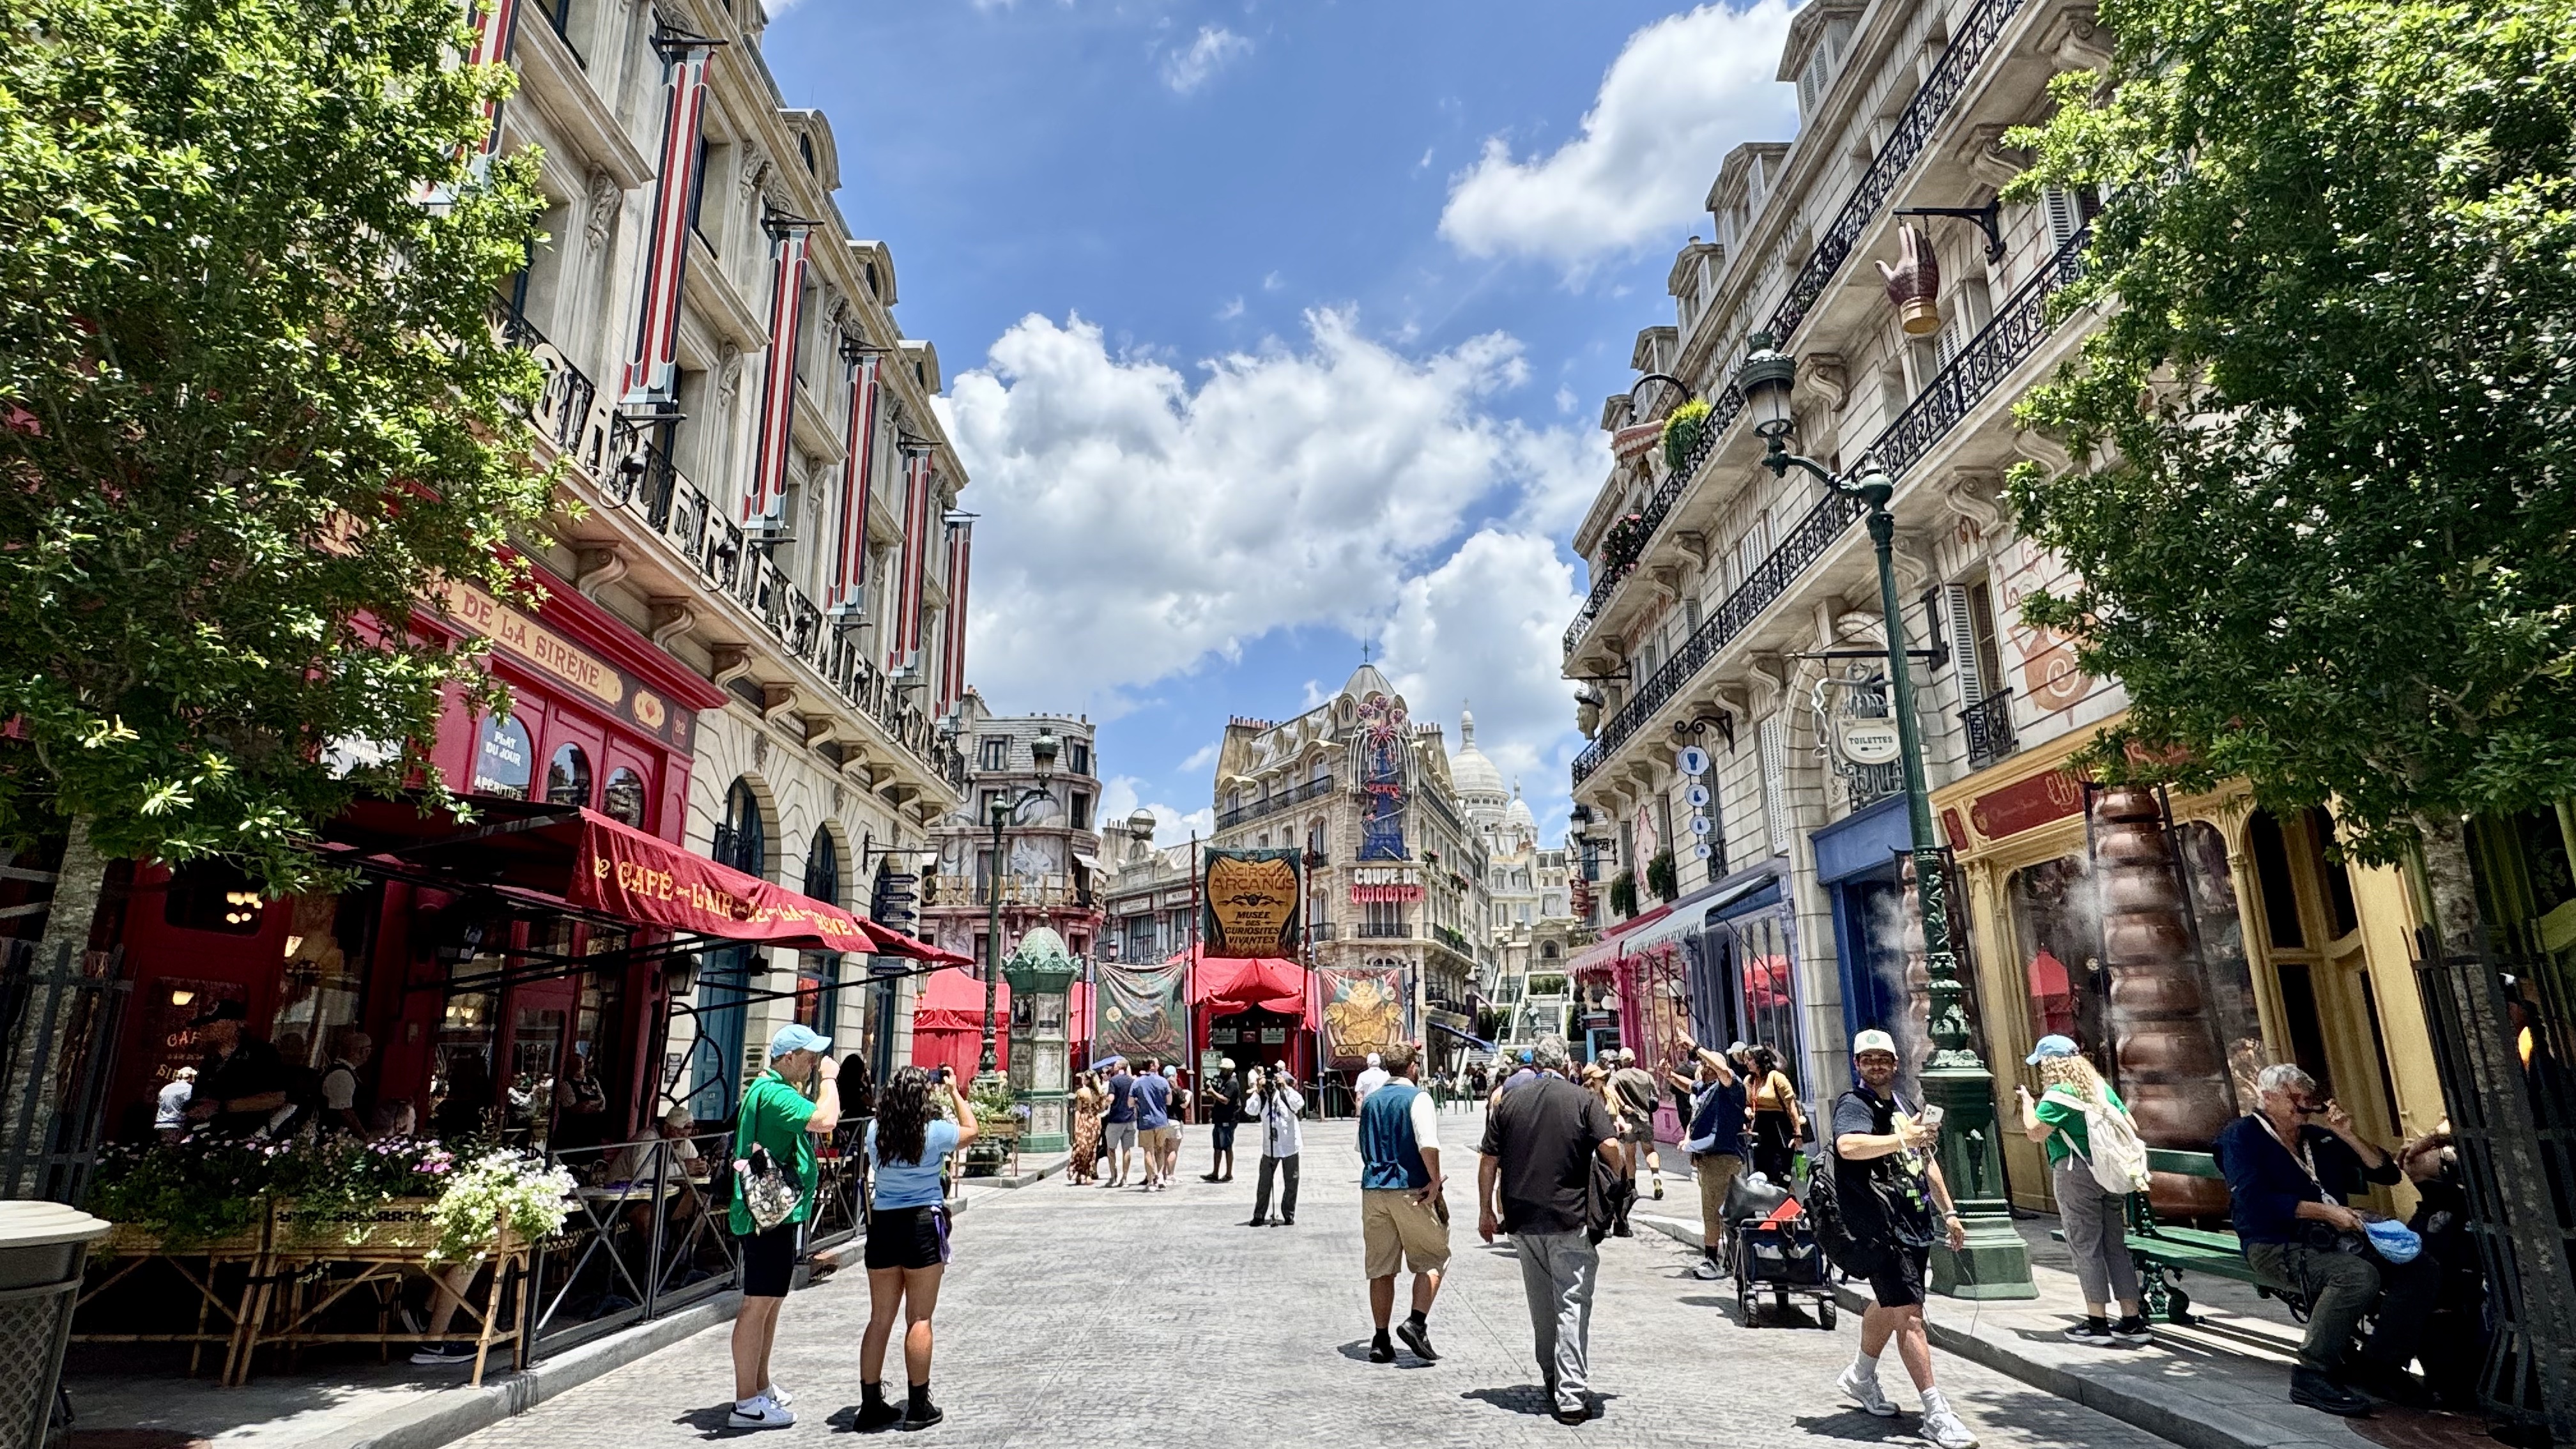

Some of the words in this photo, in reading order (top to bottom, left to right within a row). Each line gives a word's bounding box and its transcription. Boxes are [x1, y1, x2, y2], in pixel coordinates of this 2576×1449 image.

[531, 343, 797, 641] GALERIES
[462, 591, 493, 627] DE
[502, 614, 528, 649] LA
[535, 634, 600, 690] SIRÈNE
[675, 718, 686, 735] 32
[494, 731, 517, 750] PLAT
[1848, 735, 1894, 745] TOILETTES
[486, 741, 498, 756] DU
[499, 747, 521, 767] JOUR
[474, 775, 523, 801] APÉRITIFS
[1211, 878, 1296, 891] ARCANUS
[1354, 868, 1399, 884] COUPE
[1403, 868, 1421, 884] DE
[618, 861, 673, 901] CAFÉ
[691, 883, 734, 922] L'AIR
[776, 903, 807, 921] LA
[1351, 885, 1425, 904] QUIDDITCH
[1236, 910, 1271, 921] MUSÉE
[1228, 935, 1276, 944] VIVANTES
[166, 1031, 203, 1047] CAF
